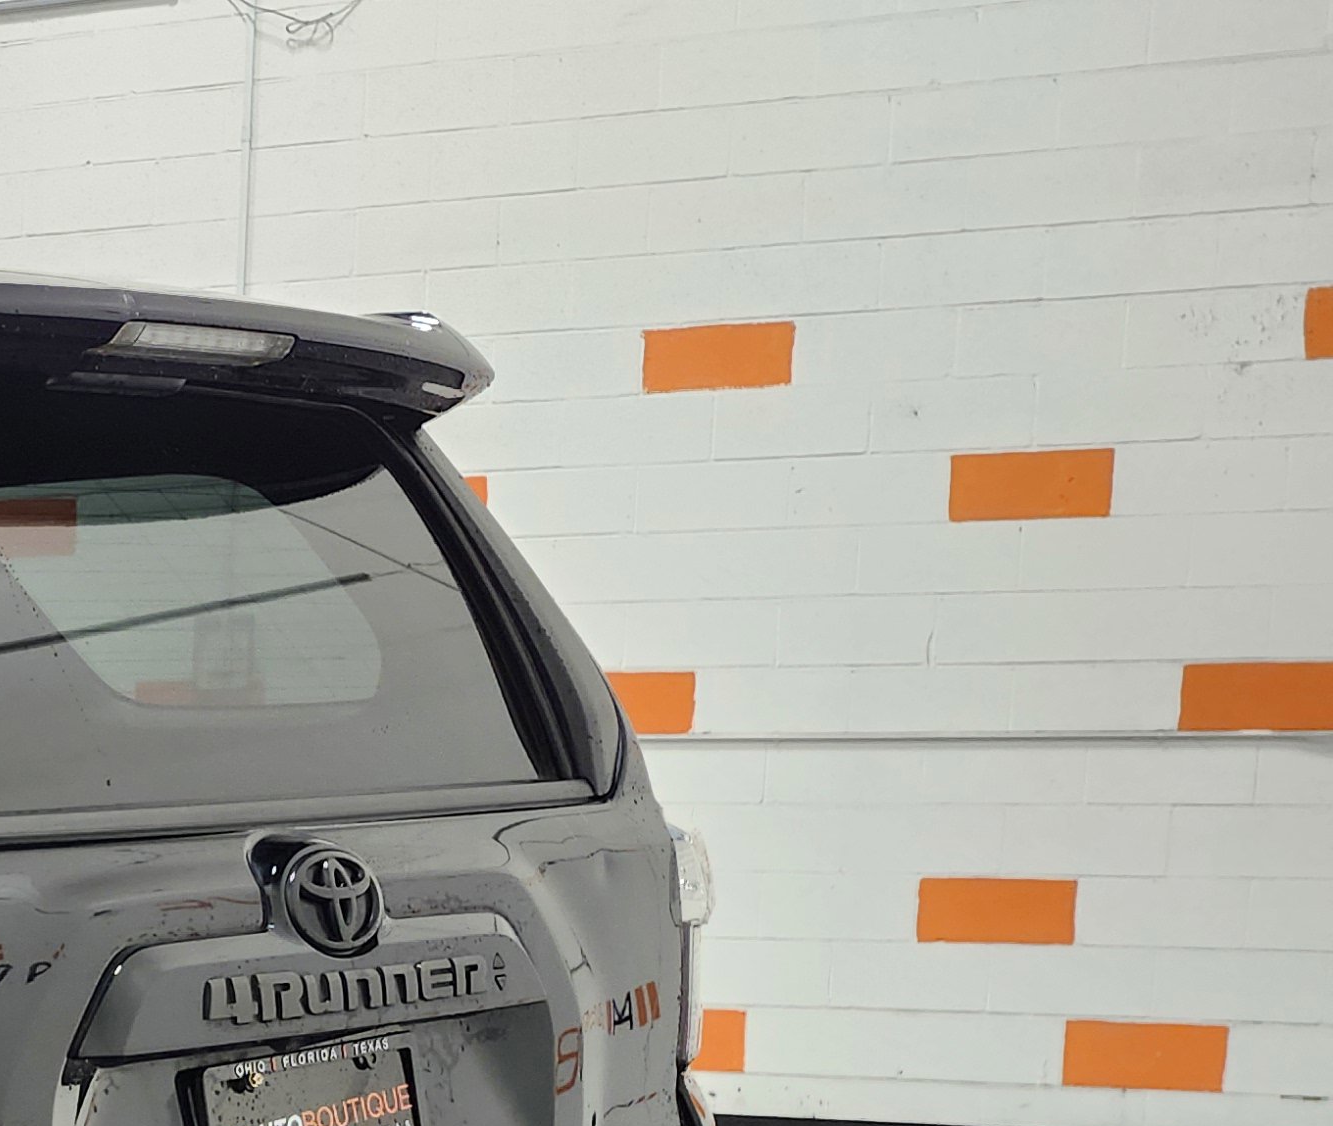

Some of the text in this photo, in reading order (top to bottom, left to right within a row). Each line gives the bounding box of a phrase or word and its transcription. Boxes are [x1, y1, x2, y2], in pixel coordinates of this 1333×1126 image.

[235, 1037, 390, 1079] OHIO FLORIDA TEXAS
